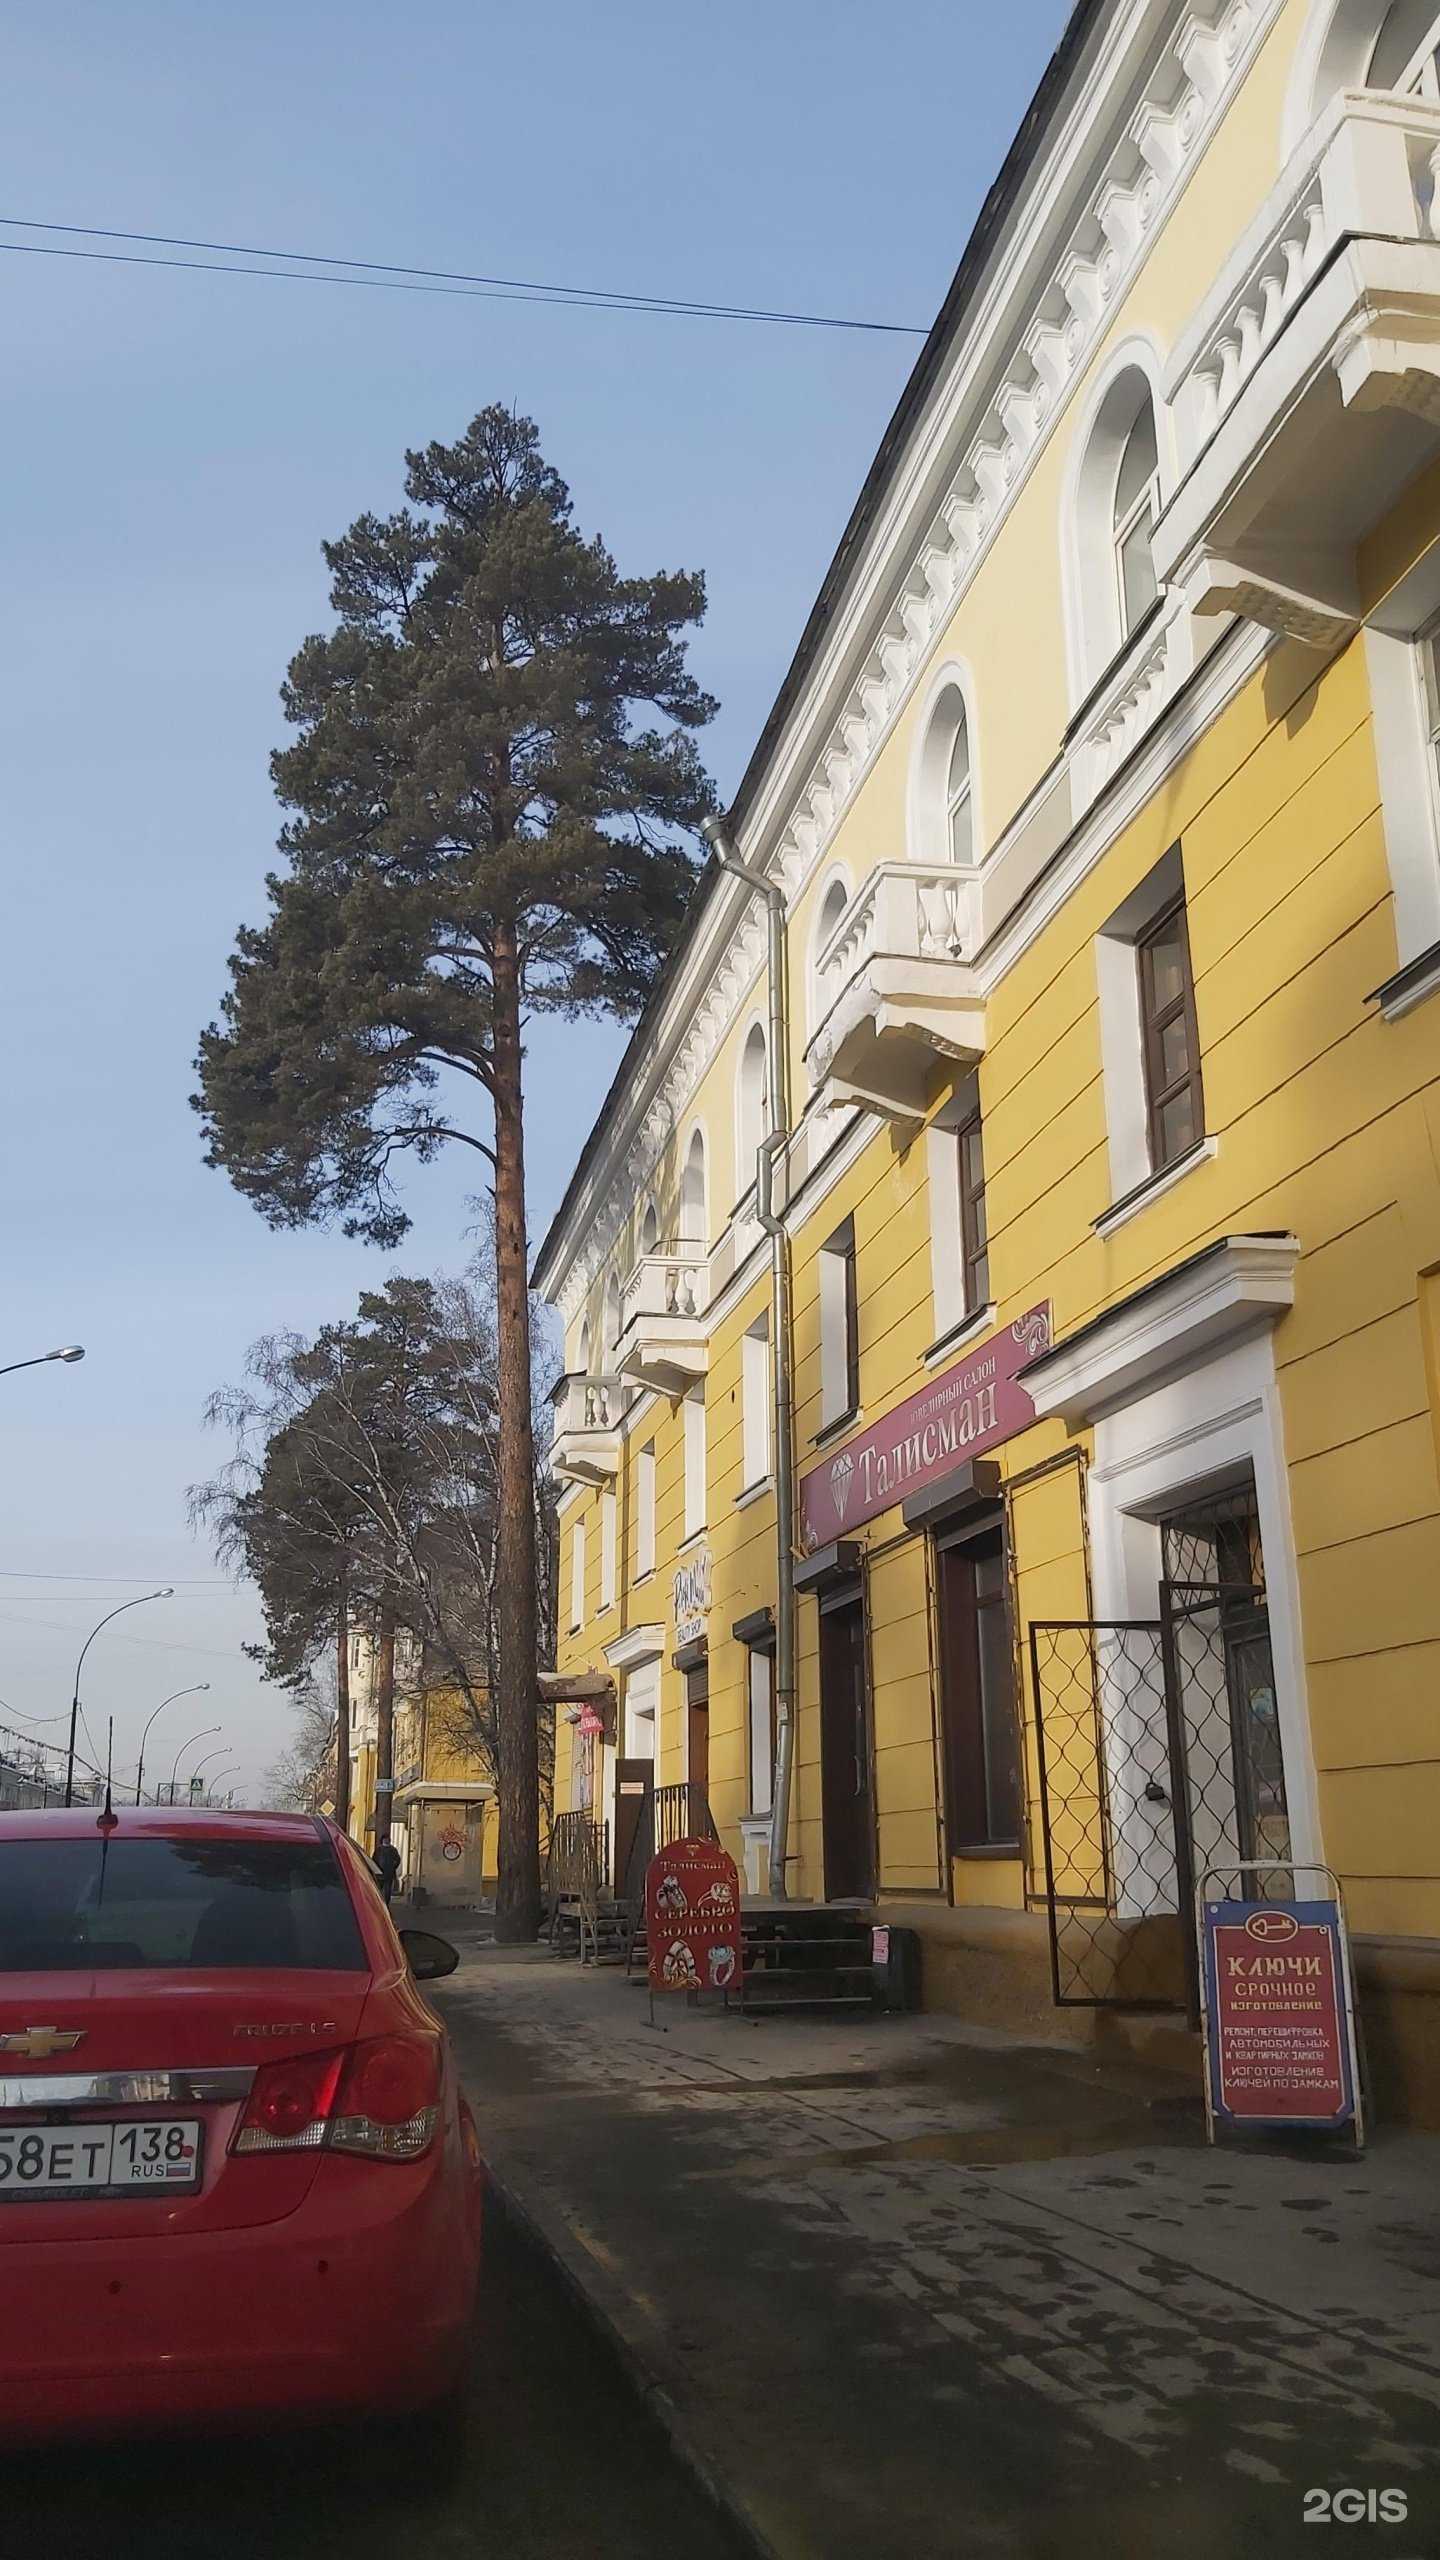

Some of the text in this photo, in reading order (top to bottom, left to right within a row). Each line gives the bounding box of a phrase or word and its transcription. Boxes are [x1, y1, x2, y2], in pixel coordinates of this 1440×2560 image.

[963, 1355, 996, 1391] САЛОН
[859, 1382, 998, 1504] Талисман
[657, 1925, 733, 1938] ЗОЛОТО
[1227, 1956, 1323, 1976] КЛЮЧИ
[1229, 2039, 1331, 2049] АВТОМОБИЛЬНЫХ
[1273, 2079, 1289, 2089] ПО
[119, 2127, 185, 2163] 138
[131, 2164, 165, 2178] RUS
